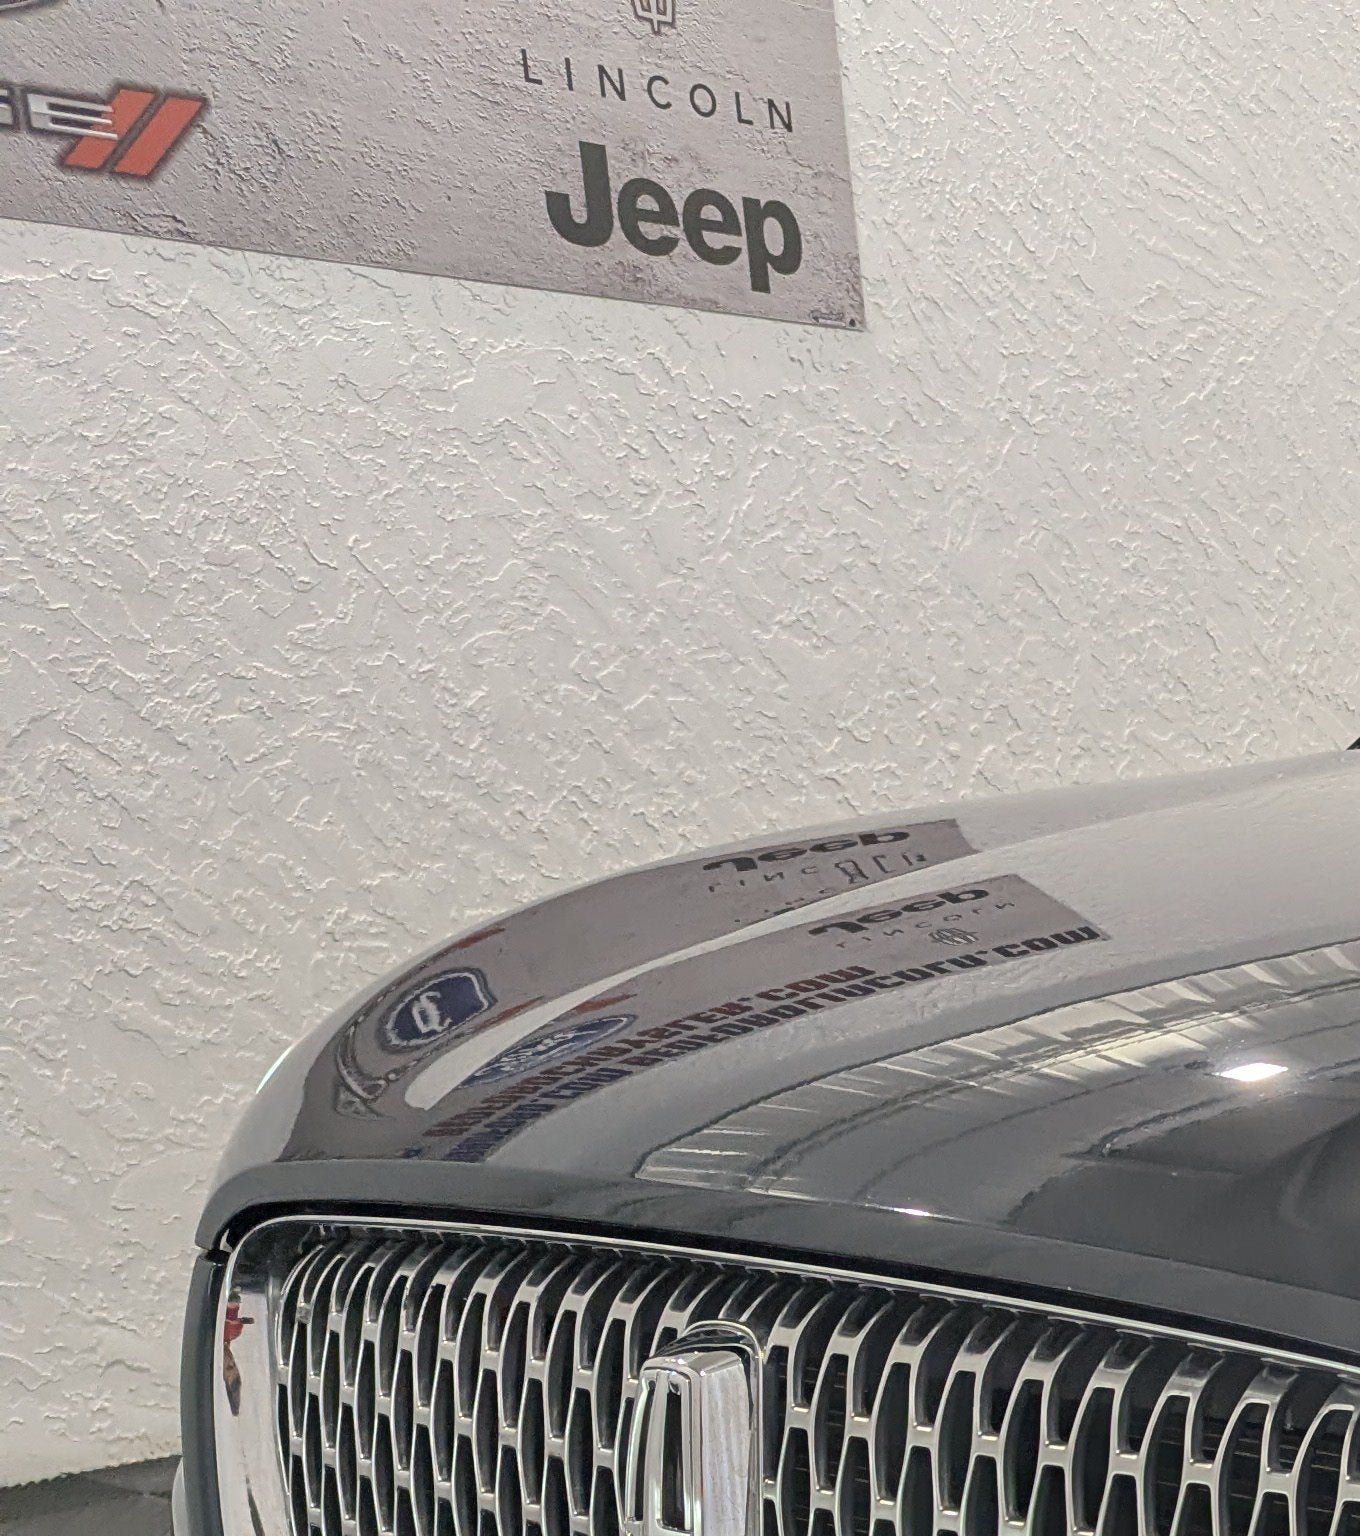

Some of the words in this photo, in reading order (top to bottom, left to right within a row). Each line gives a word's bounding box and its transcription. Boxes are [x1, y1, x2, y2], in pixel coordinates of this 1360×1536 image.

[0, 88, 119, 141] E
[520, 48, 794, 134] LINCOLN
[545, 140, 803, 293] Jeep
